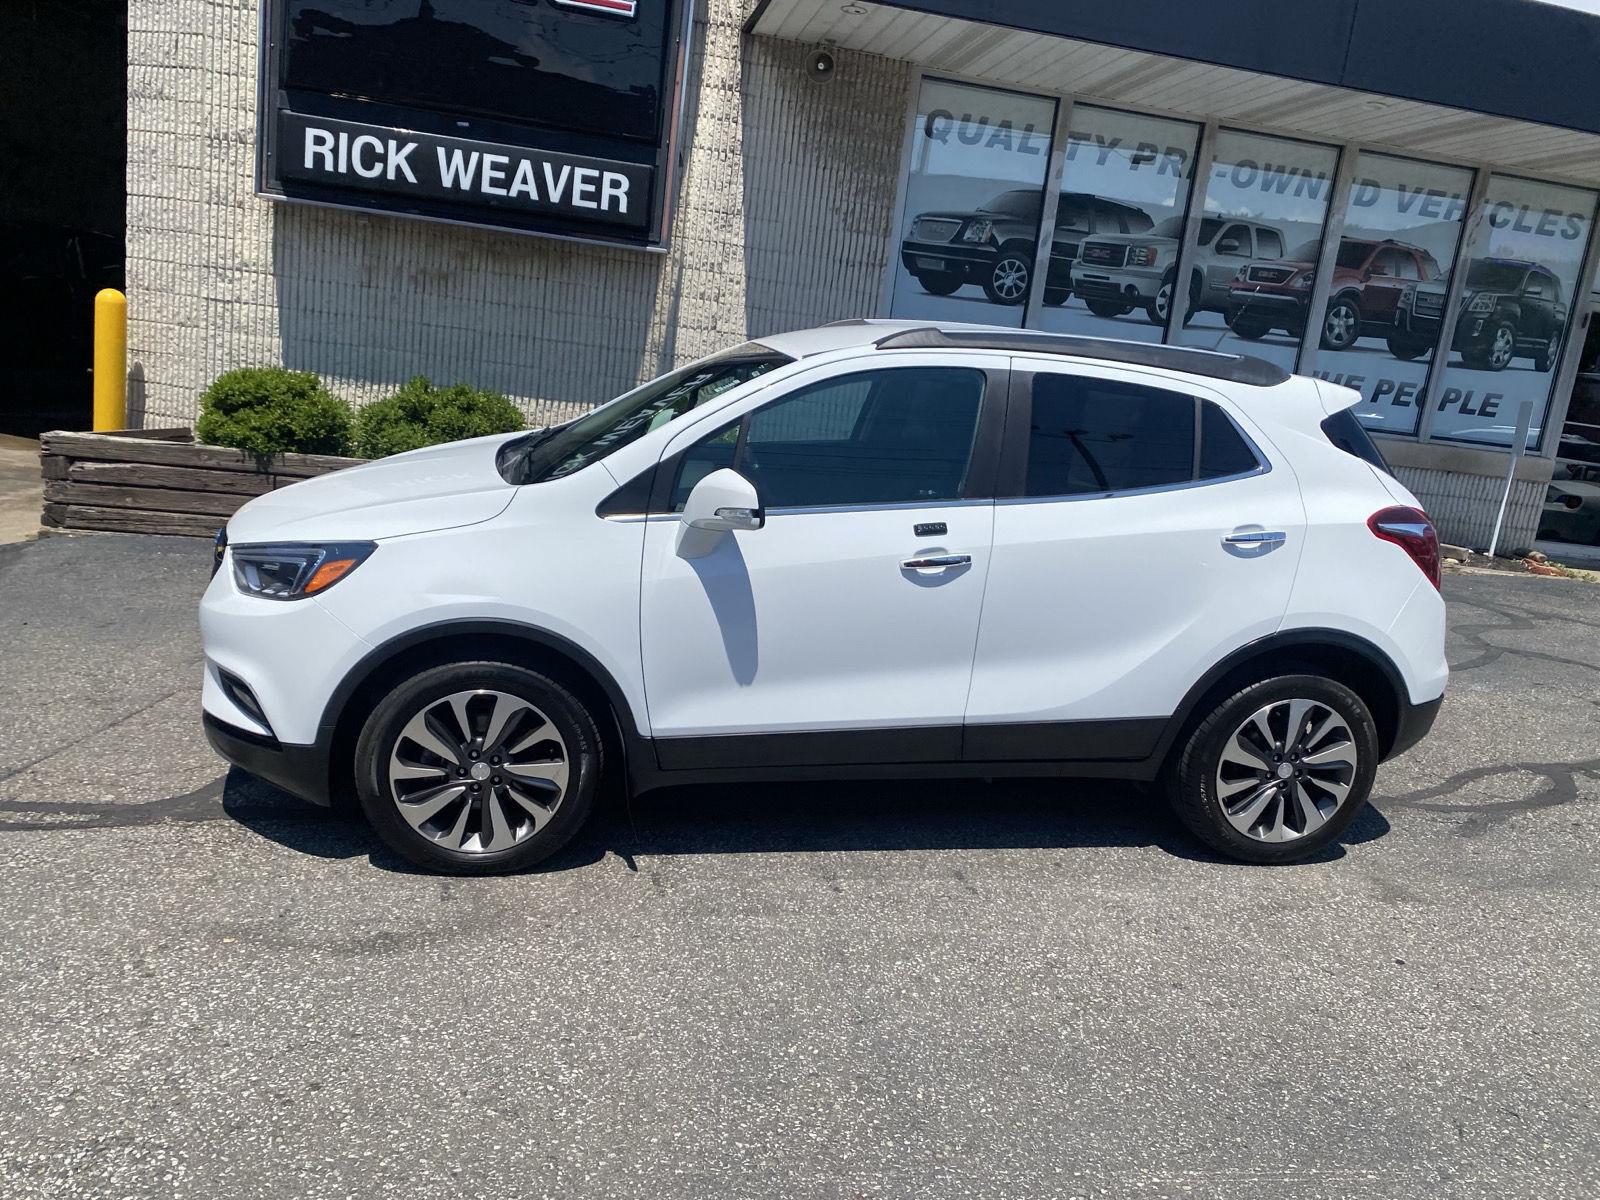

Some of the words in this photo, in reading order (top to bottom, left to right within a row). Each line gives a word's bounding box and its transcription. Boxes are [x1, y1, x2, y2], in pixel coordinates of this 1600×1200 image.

[304, 126, 419, 184] RICK
[436, 145, 631, 214] WEAVER
[924, 108, 1123, 166] QUALTY
[1129, 142, 1381, 208] PR-OWND
[1397, 184, 1586, 240] VEHCLES
